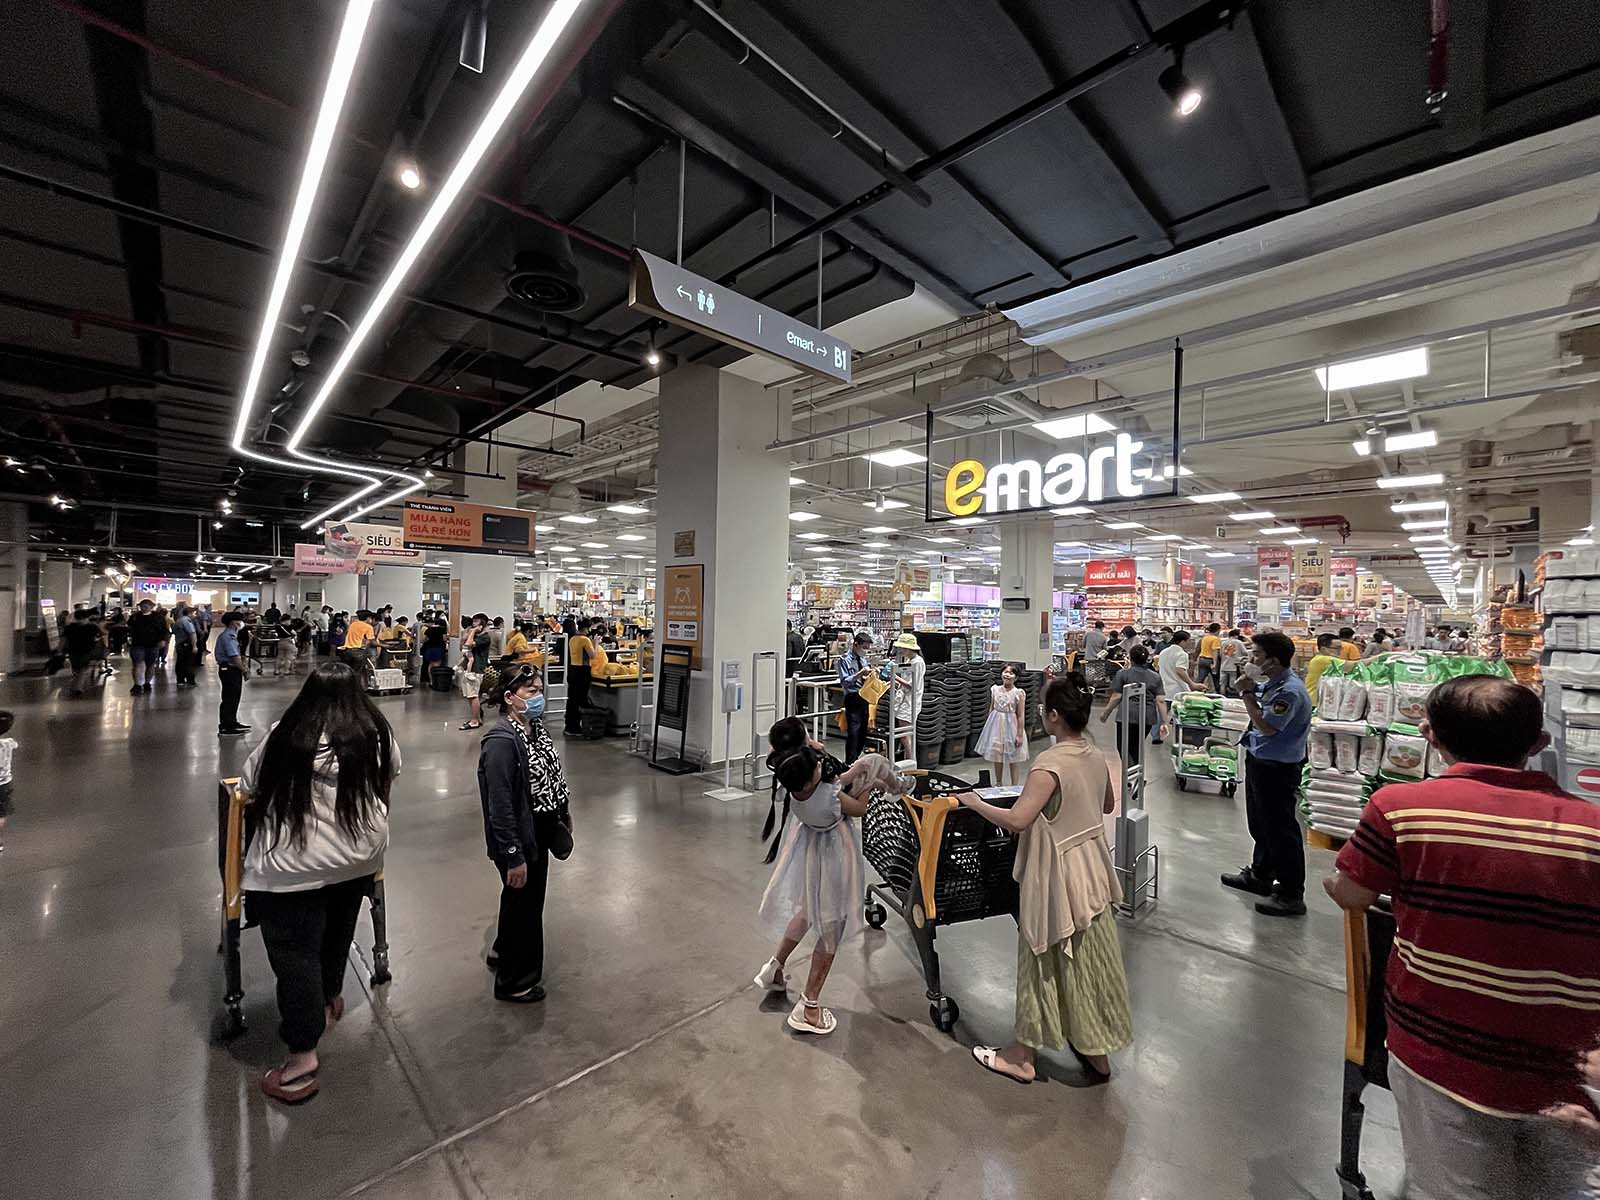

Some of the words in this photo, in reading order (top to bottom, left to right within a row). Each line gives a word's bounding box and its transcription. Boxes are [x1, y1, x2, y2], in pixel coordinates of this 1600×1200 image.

[786, 331, 815, 353] emart
[834, 346, 847, 371] B1
[945, 432, 1145, 516] emart
[410, 513, 437, 523] MUA
[439, 515, 471, 527] HÀNG
[410, 523, 429, 533] GIÁ
[431, 526, 446, 535] RẺ
[448, 528, 471, 537] HƠN
[367, 534, 392, 547] SIÊU
[1301, 555, 1323, 566] SIÊU
